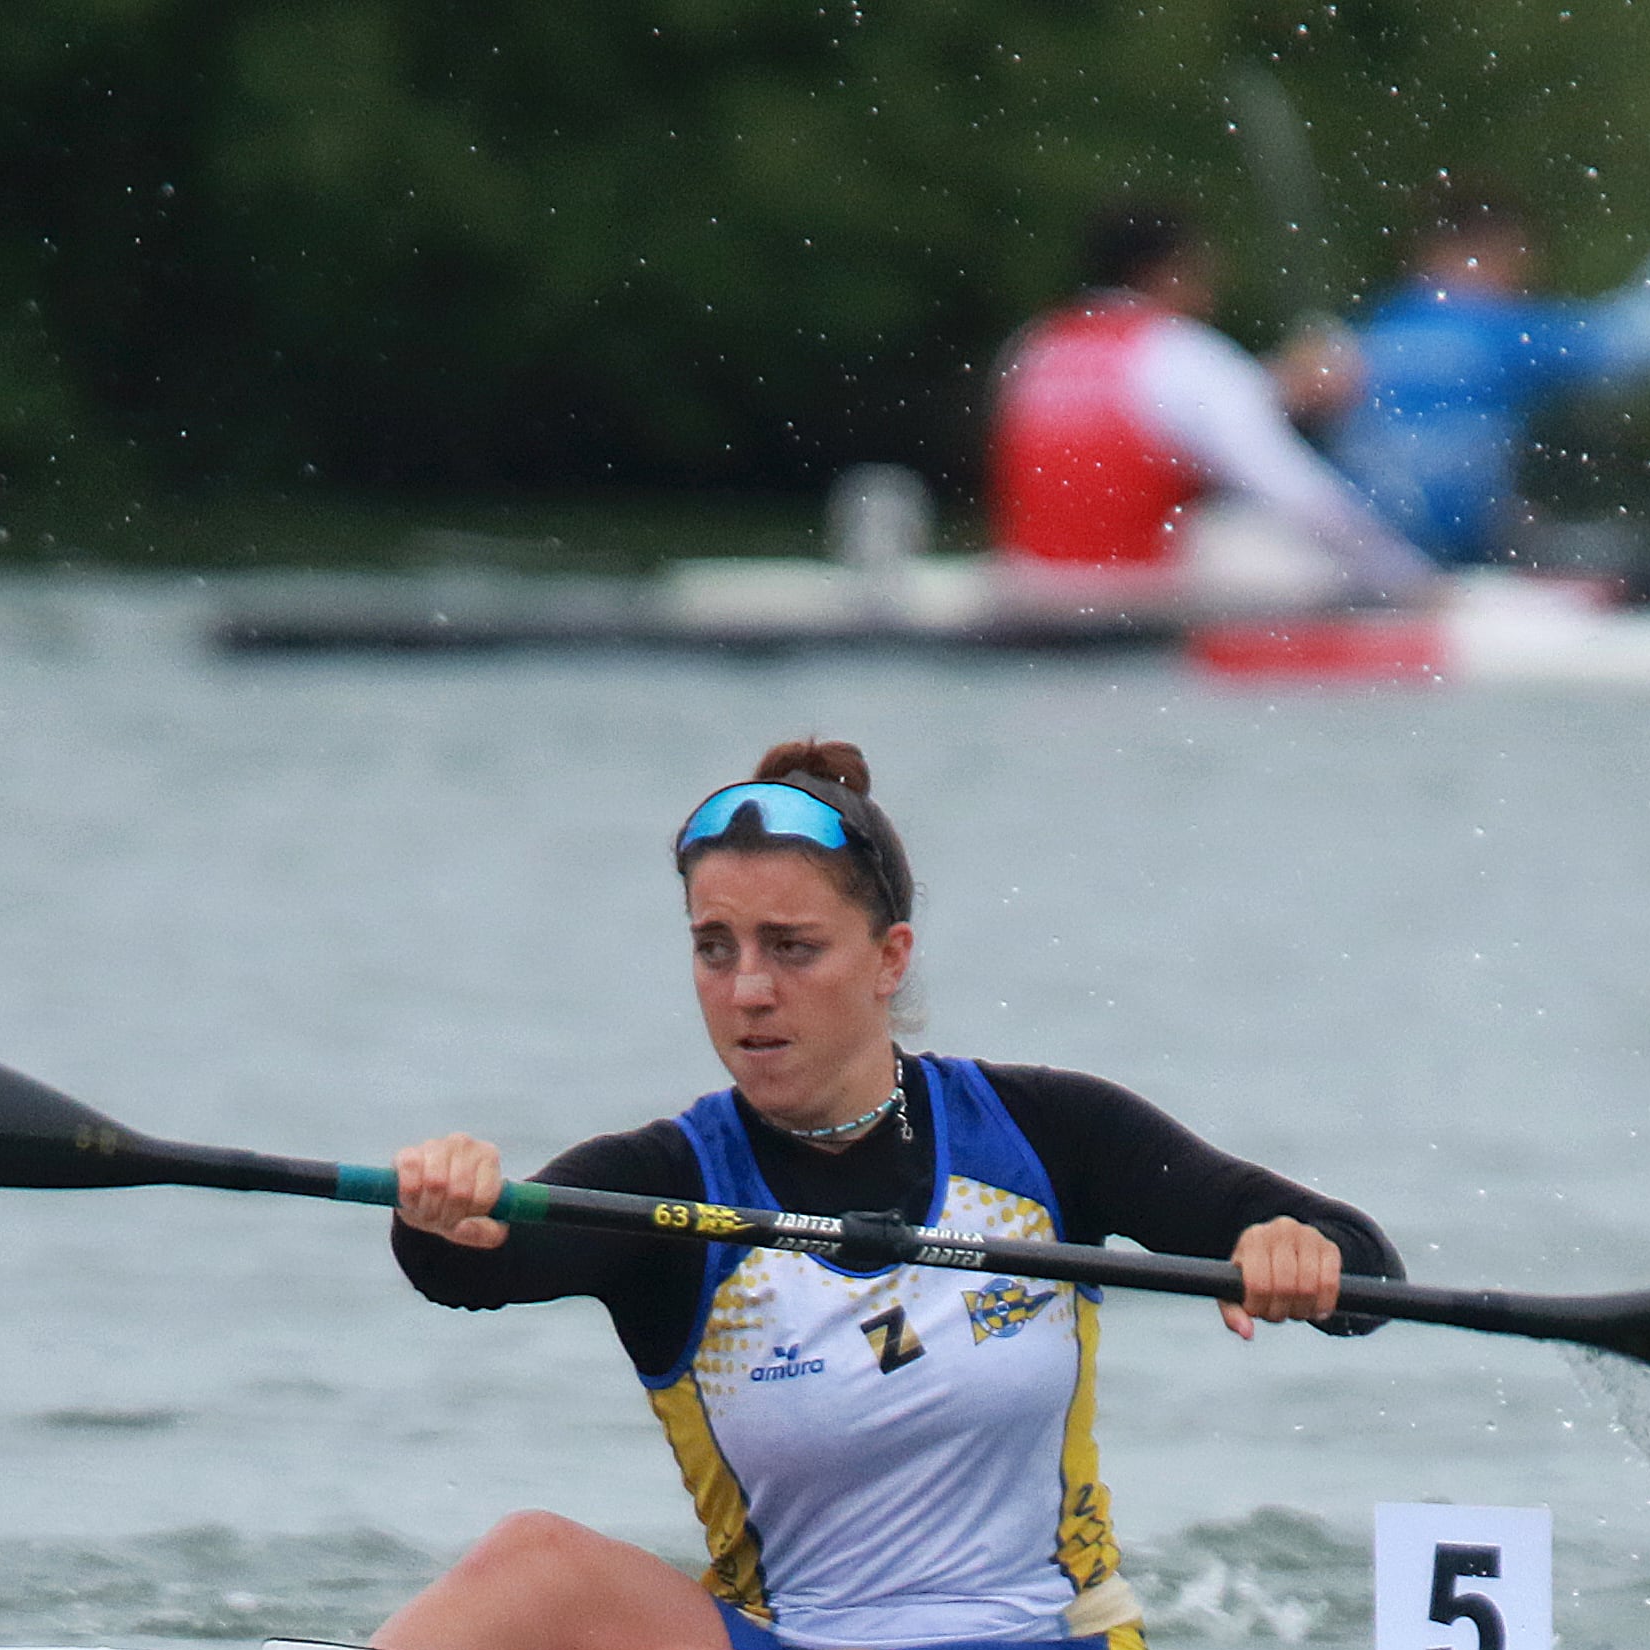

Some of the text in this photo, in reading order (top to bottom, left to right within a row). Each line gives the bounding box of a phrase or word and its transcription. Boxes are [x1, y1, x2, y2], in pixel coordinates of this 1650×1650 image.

[654, 1203, 690, 1228] 63
[774, 1212, 844, 1233] JANTEX
[860, 1305, 927, 1375] Z
[751, 1358, 825, 1382] amura
